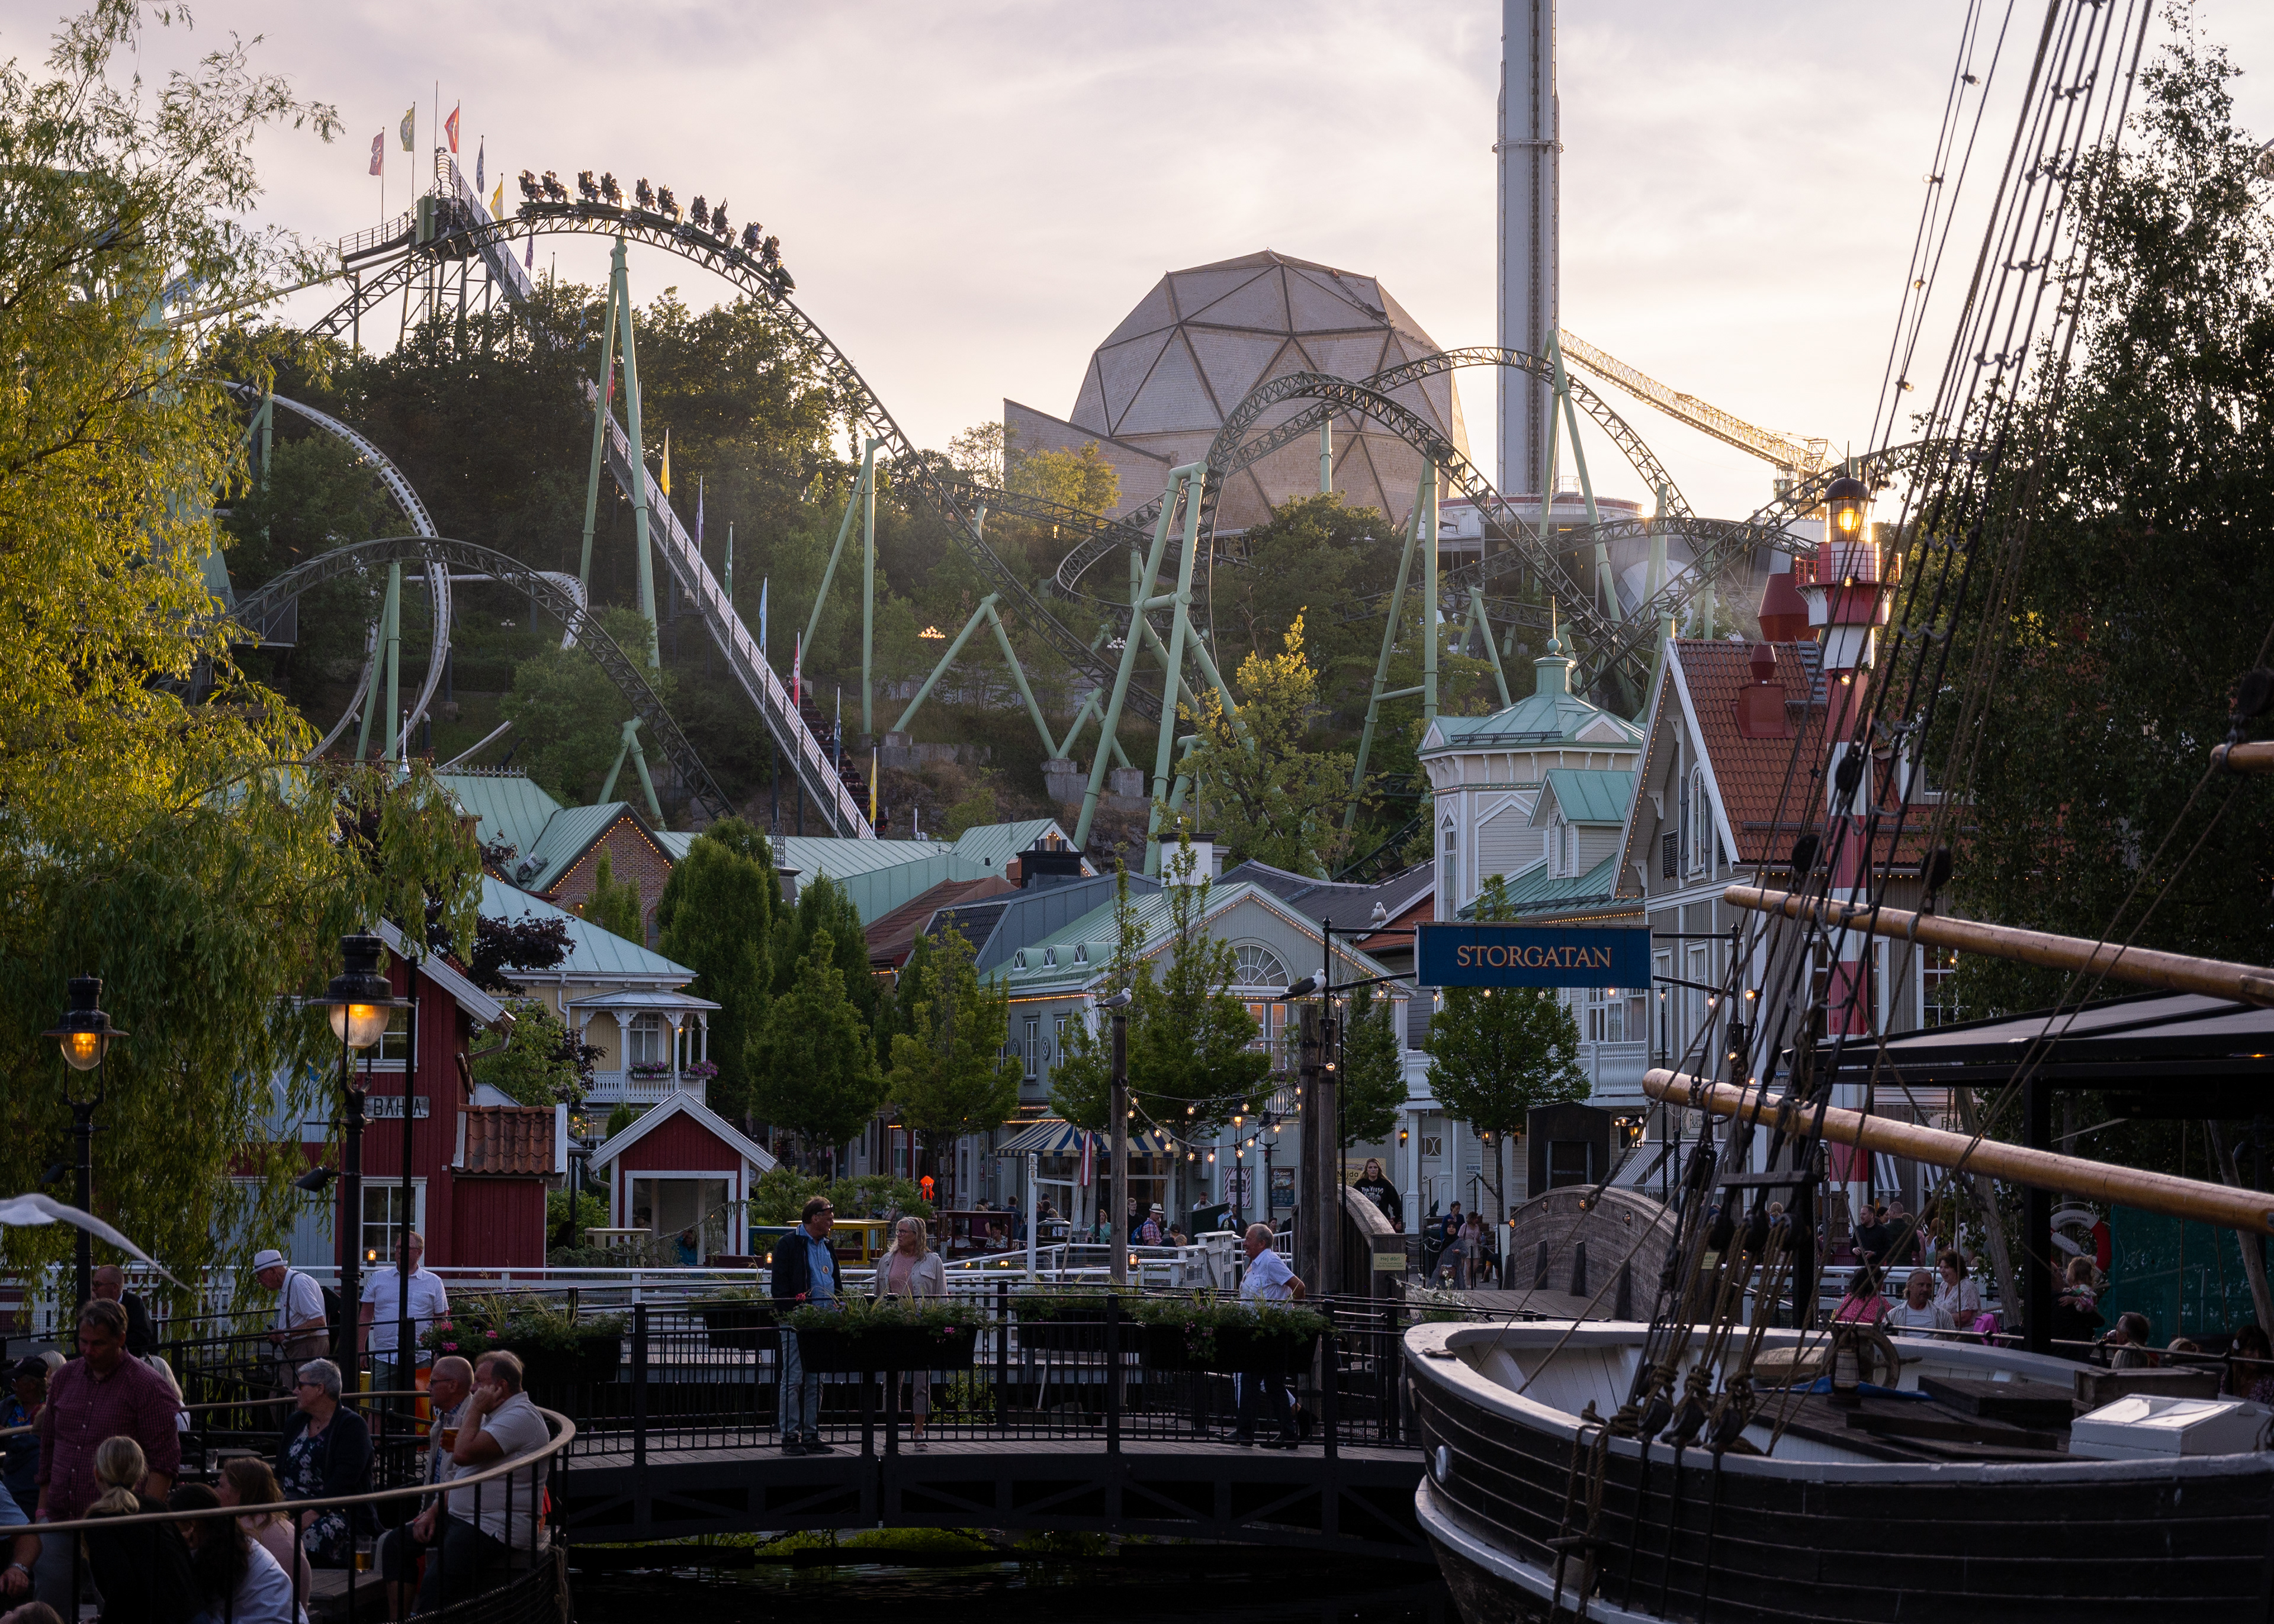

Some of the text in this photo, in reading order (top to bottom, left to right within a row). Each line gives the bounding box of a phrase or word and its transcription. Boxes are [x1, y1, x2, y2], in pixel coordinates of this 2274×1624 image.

[1457, 945, 1611, 969] STORGATAN
[374, 1098, 422, 1116] BAHA
[1337, 1171, 1358, 1179] Njda
